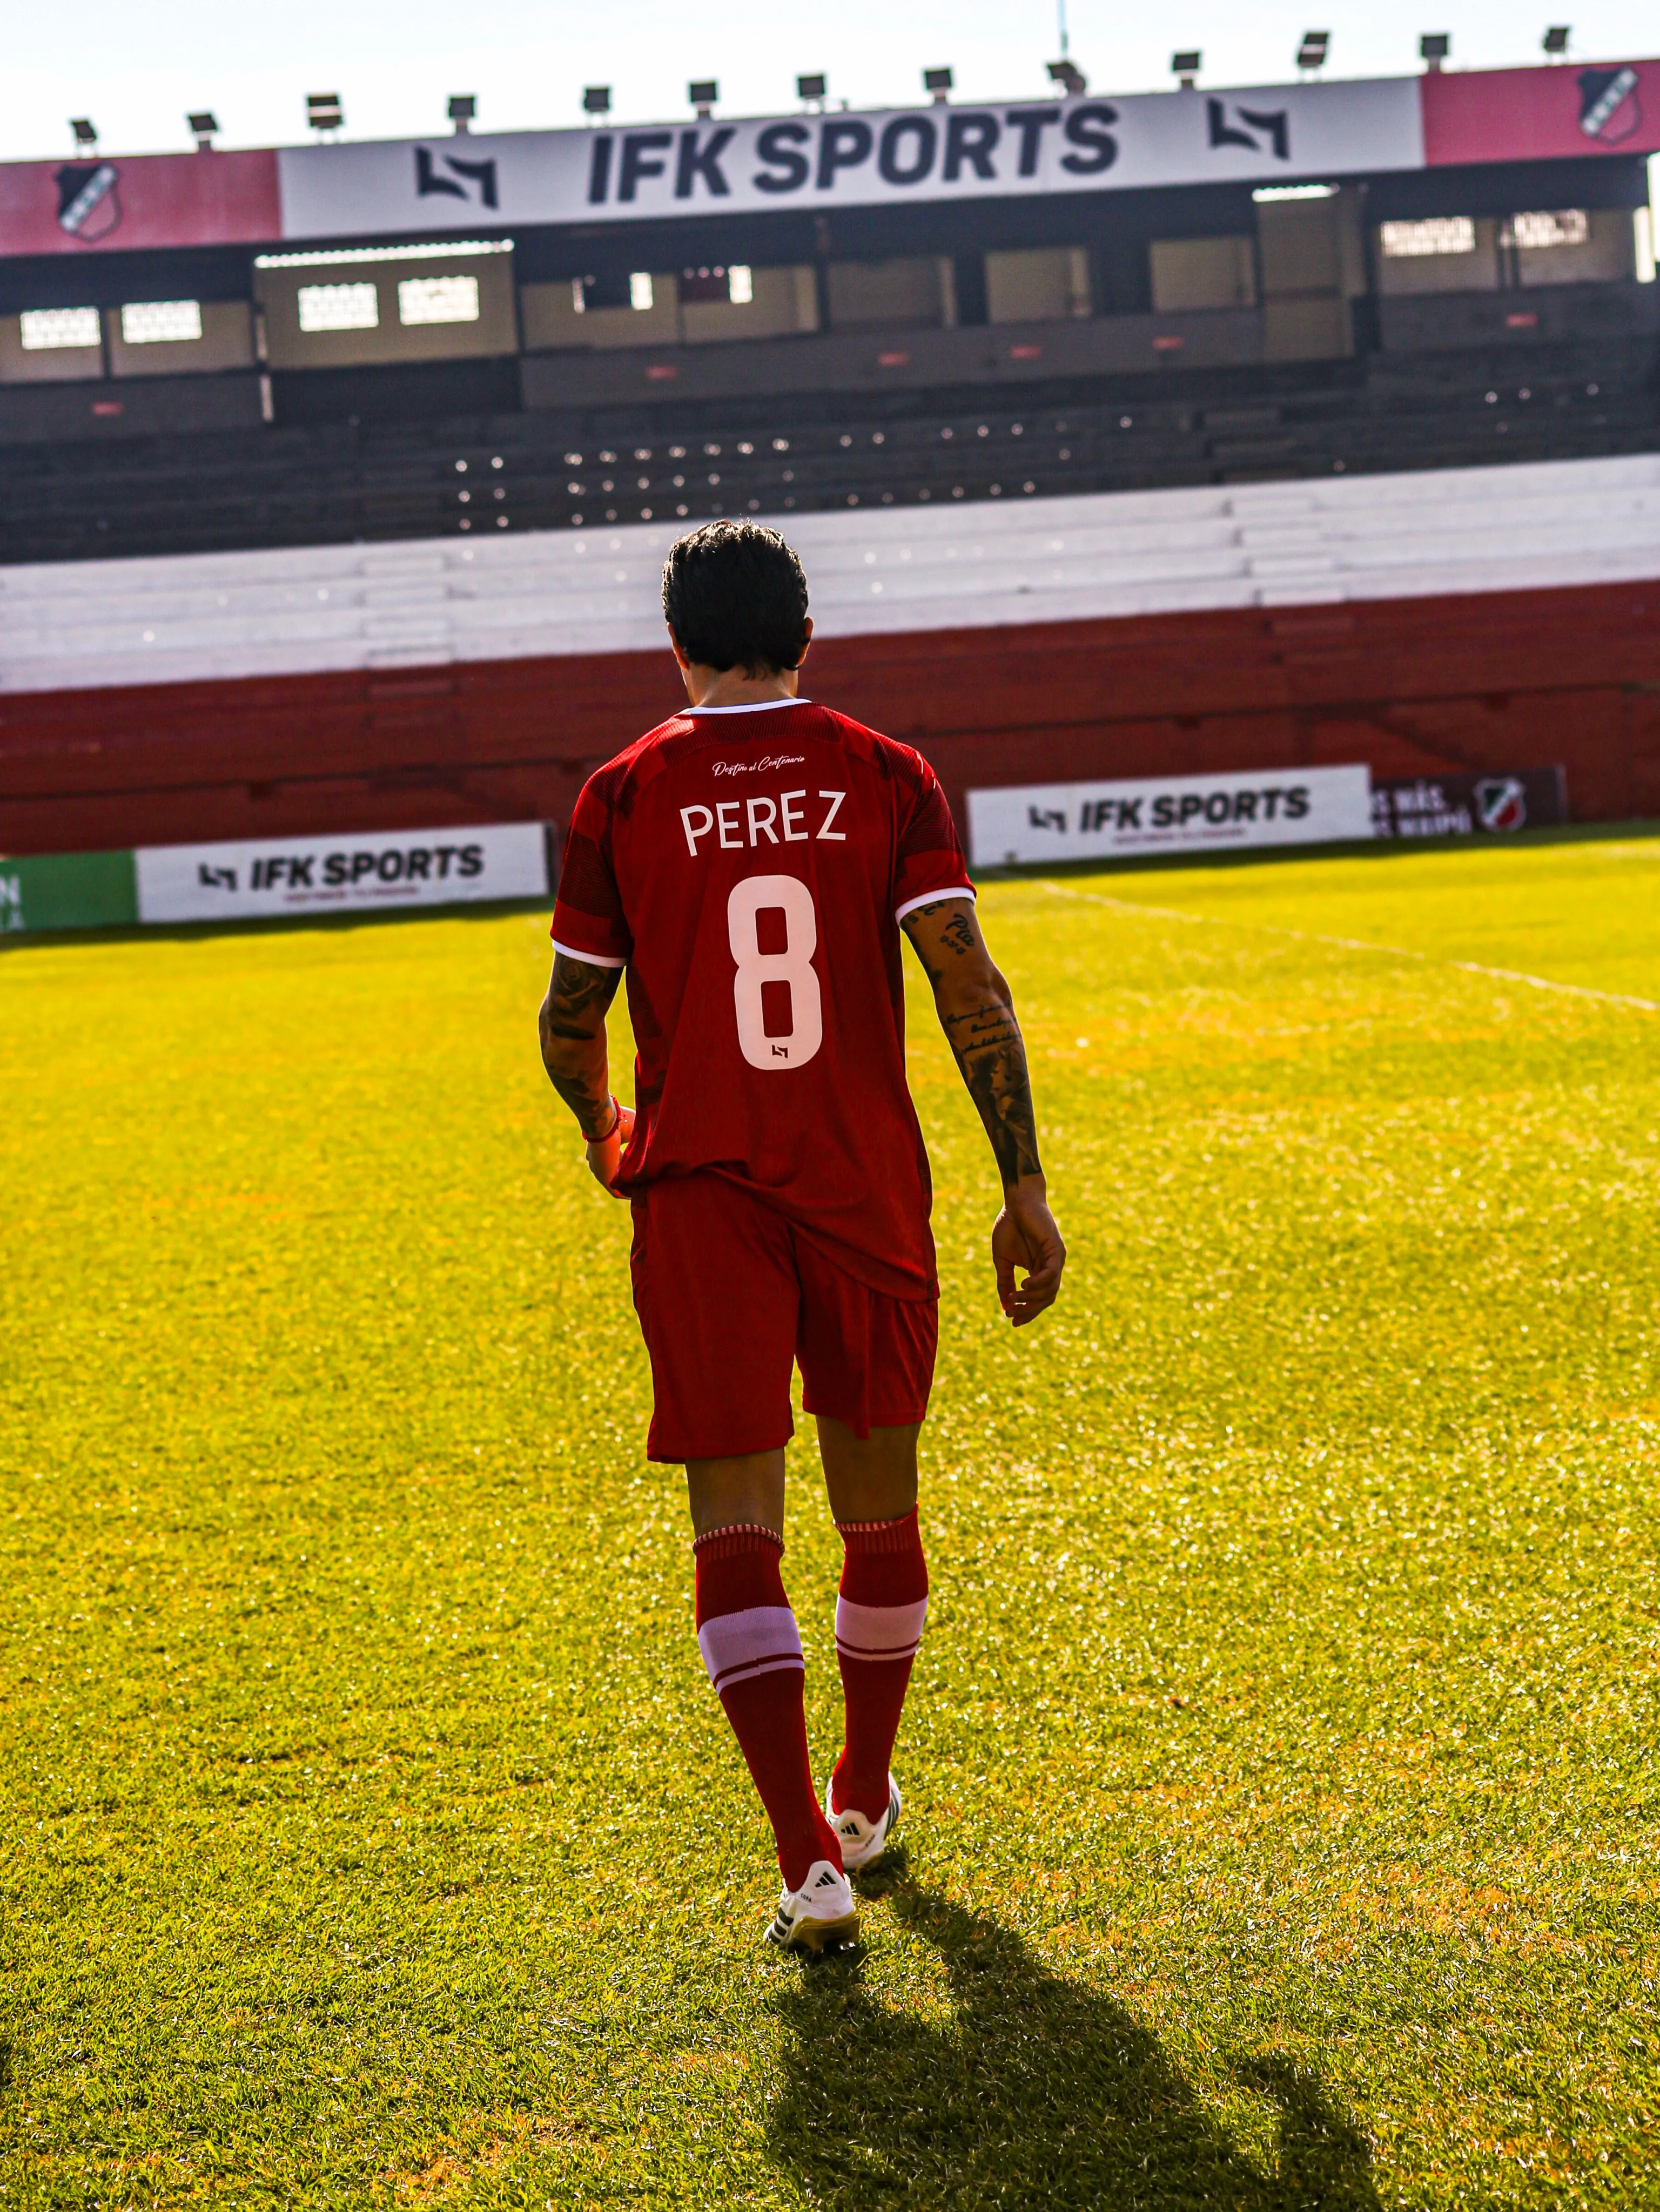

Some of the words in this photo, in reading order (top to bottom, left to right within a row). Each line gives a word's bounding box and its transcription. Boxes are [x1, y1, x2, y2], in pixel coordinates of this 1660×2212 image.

[588, 126, 737, 205] IFK
[752, 103, 1120, 194] SPORTS
[712, 761, 748, 777] Destino
[749, 762, 757, 771] al
[757, 755, 805, 771] Centenario
[680, 789, 846, 857] PEREZ
[1081, 798, 1142, 832] IFK
[1151, 786, 1310, 827] SPORTS
[251, 854, 314, 891] IFK
[322, 844, 483, 886] SPORTS
[727, 874, 823, 1070] 8
[801, 1893, 812, 1902] COPA
